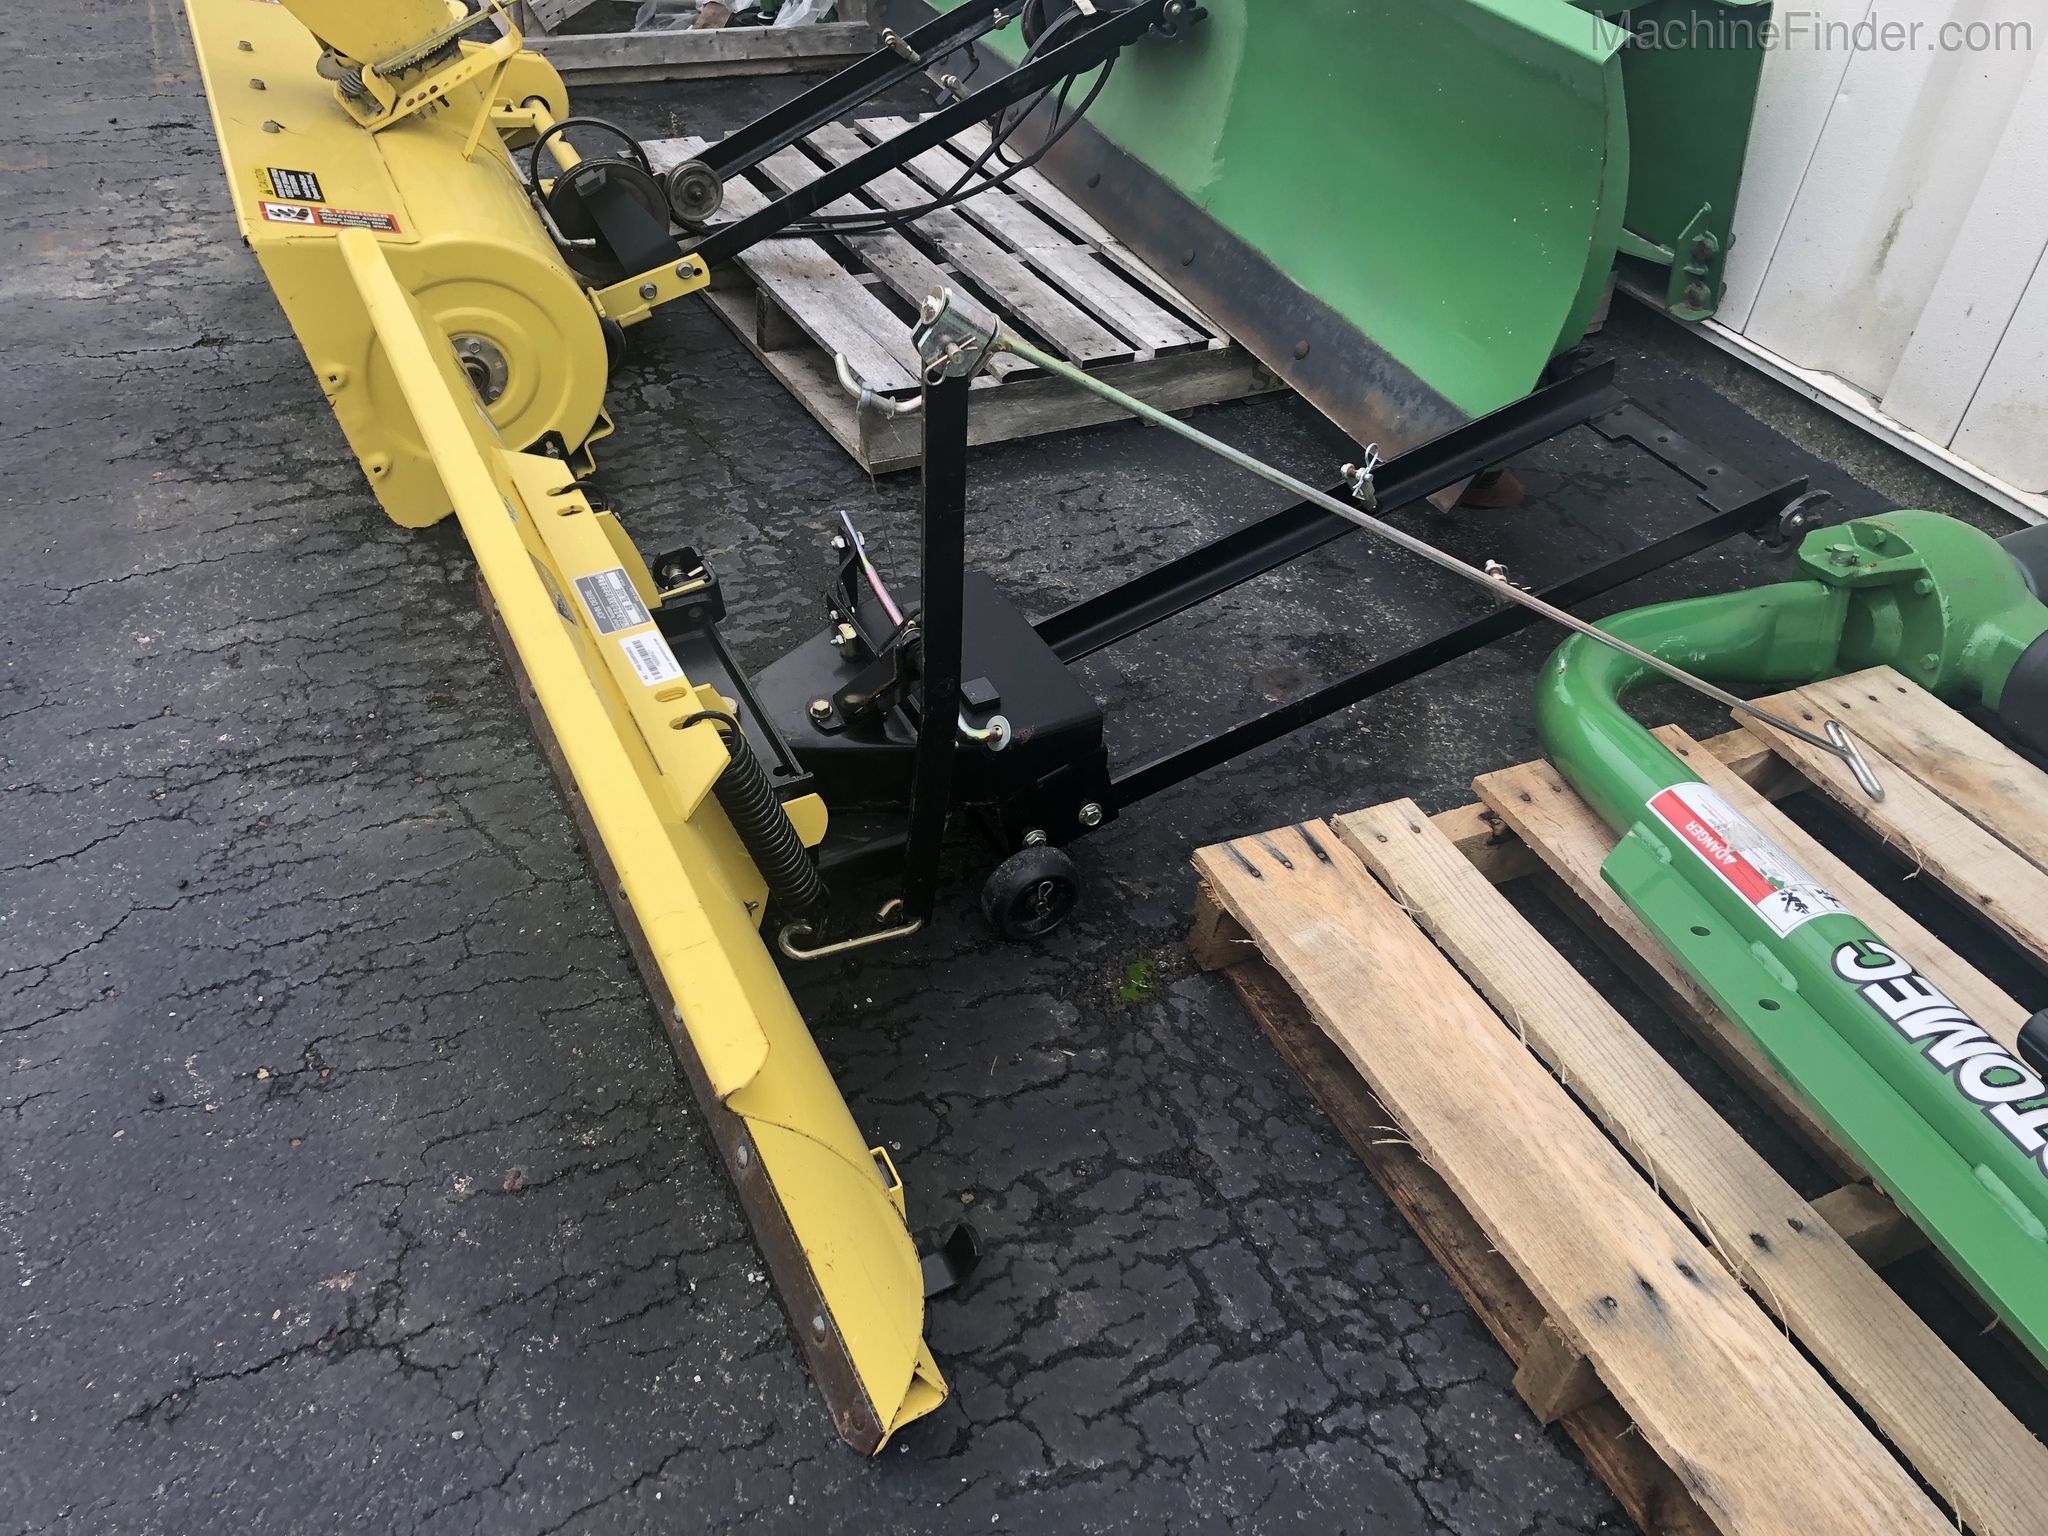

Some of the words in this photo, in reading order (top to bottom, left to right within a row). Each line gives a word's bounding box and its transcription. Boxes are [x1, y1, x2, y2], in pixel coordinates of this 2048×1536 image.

[336, 210, 389, 219] DANGER
[585, 590, 598, 607] DEERE
[594, 606, 606, 620] JOHN
[1685, 819, 1729, 861] DANGER
[1831, 939, 2048, 1180] TOMEC
